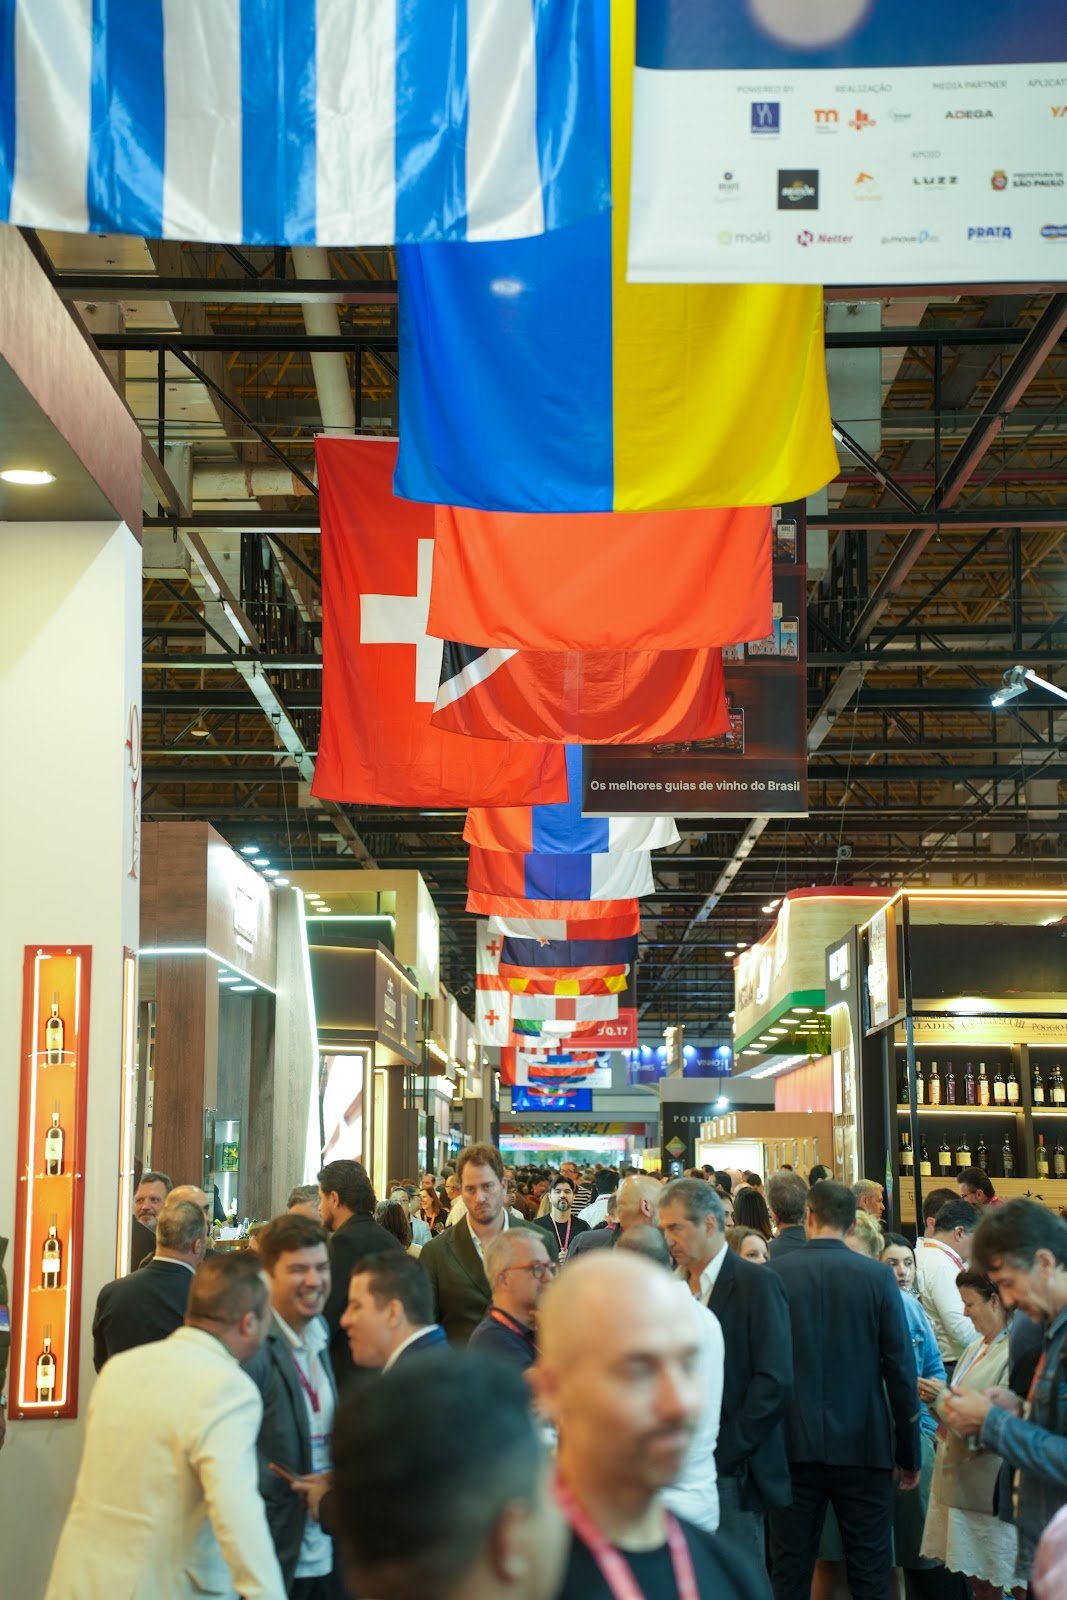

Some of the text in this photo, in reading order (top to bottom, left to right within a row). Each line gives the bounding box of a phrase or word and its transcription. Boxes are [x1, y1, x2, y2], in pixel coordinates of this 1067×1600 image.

[965, 80, 1007, 89] PARTNER
[944, 109, 993, 119] ADEGA
[913, 175, 958, 186] LUZZ
[967, 226, 1012, 240] PRATA
[590, 780, 800, 793] Os melhores guias de vinho do Brasil
